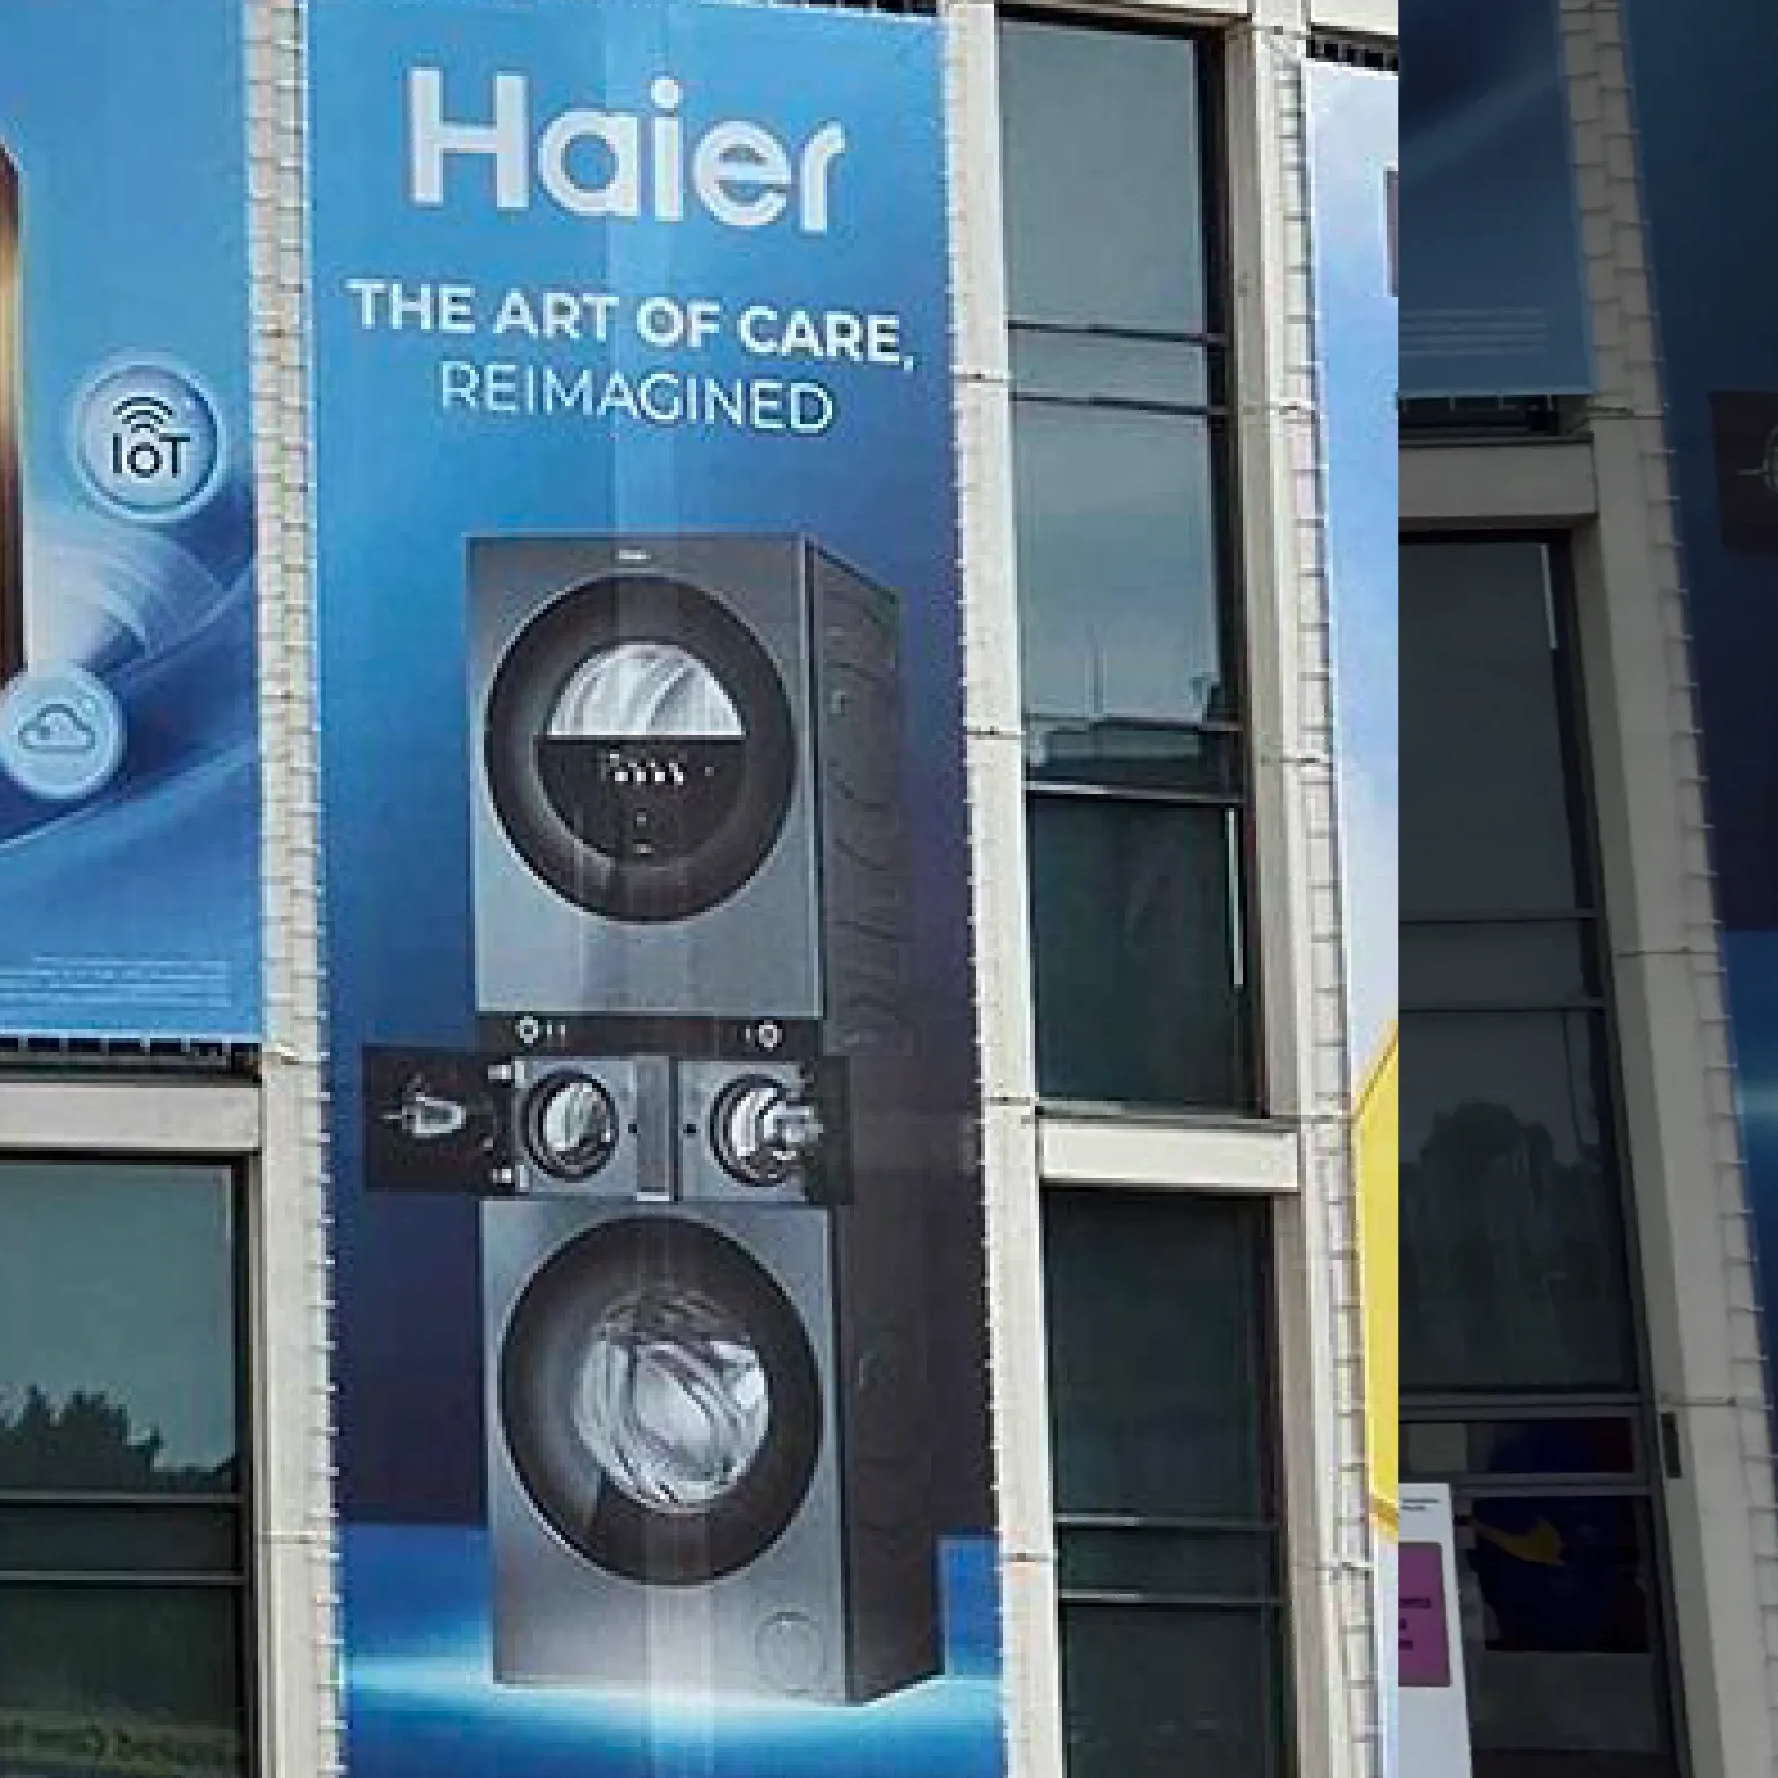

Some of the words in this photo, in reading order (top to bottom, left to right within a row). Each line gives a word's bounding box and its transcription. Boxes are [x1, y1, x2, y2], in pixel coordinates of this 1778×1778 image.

[405, 65, 844, 233] Haier
[347, 277, 476, 334] THE
[491, 286, 620, 344] ART
[636, 295, 723, 350] OF
[737, 305, 918, 372] CARE,
[440, 359, 834, 434] REIMAGINED
[111, 435, 191, 479] IoT
